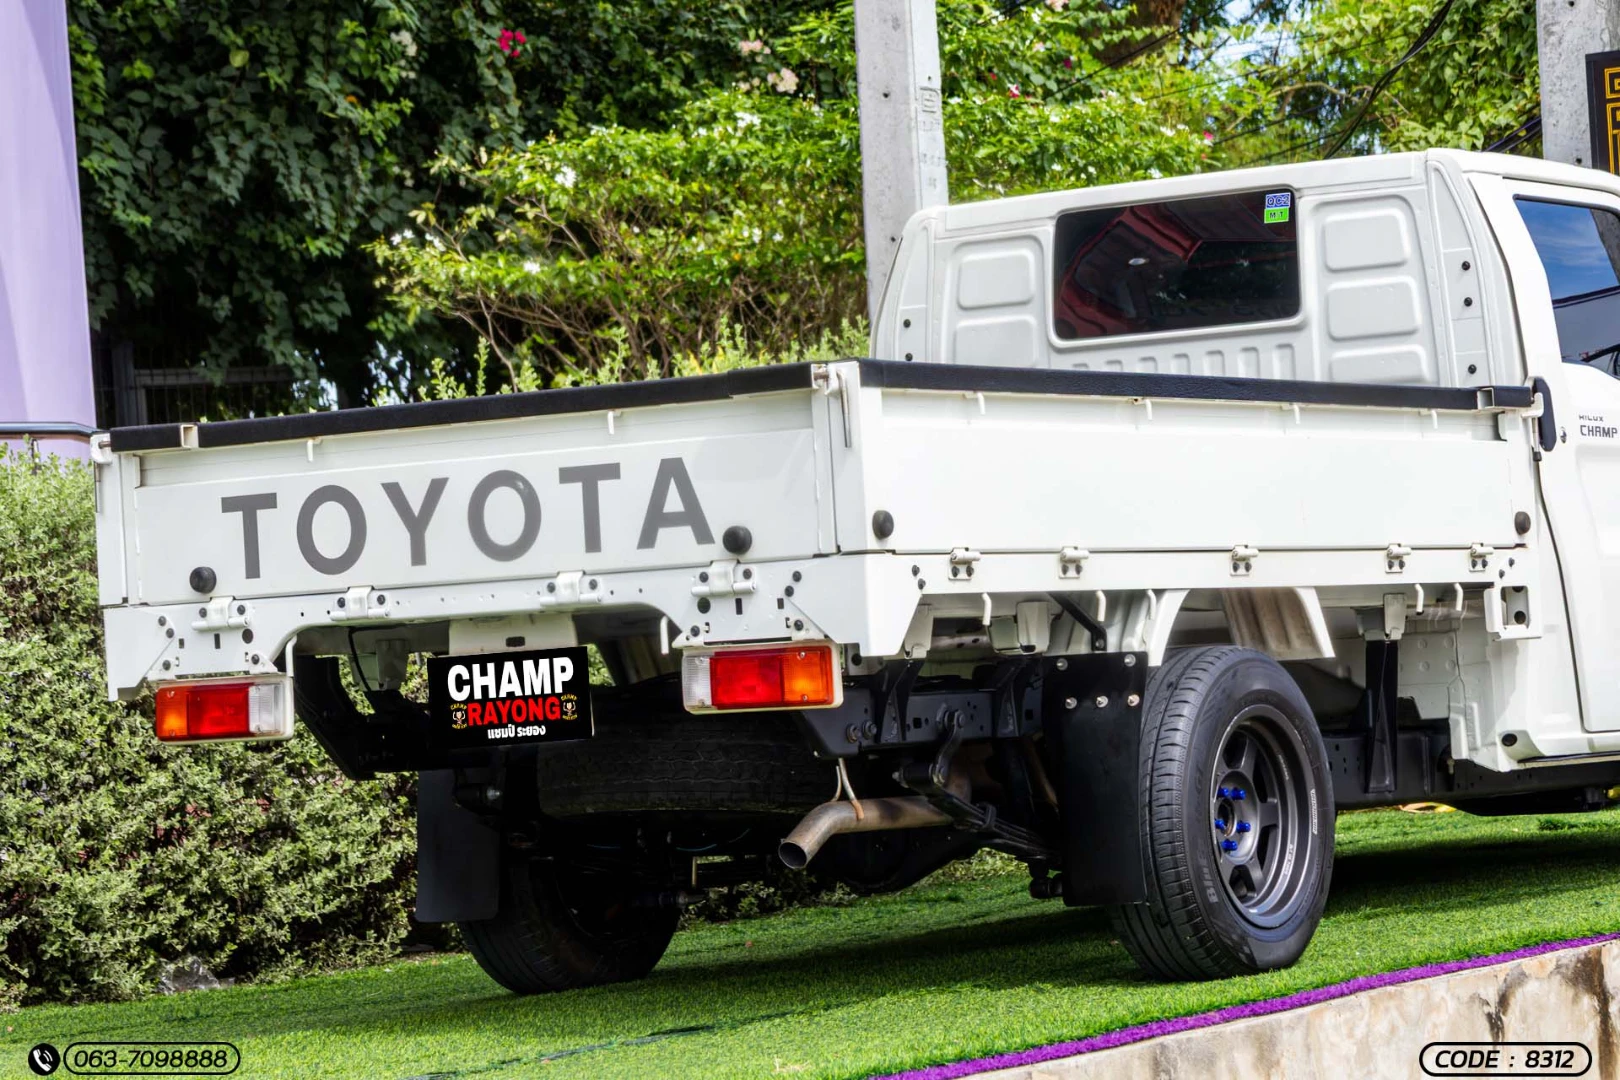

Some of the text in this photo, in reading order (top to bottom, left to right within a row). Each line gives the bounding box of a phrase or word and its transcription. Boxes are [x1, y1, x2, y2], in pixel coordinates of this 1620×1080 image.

[1579, 424, 1618, 439] CHAMP
[221, 457, 715, 580] TOYOTA
[447, 656, 574, 701] CHAMP
[467, 696, 561, 727] RAYONG
[516, 724, 547, 738] ระยอง
